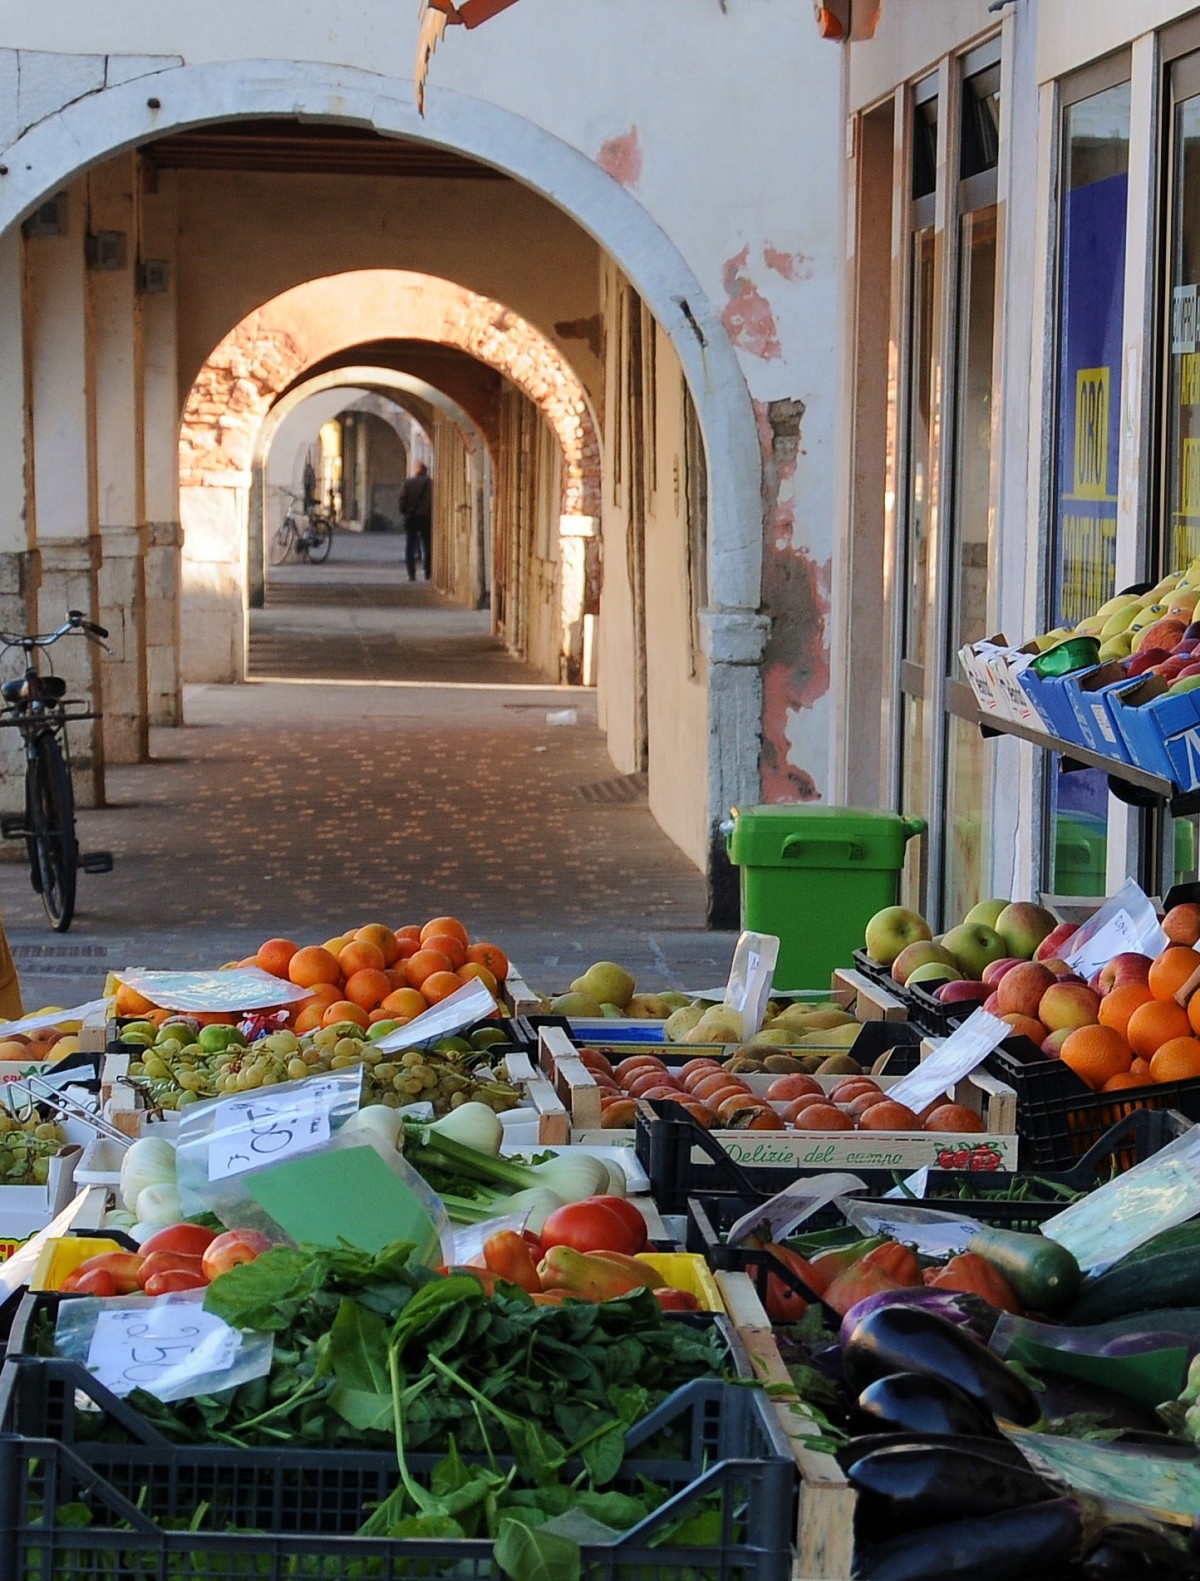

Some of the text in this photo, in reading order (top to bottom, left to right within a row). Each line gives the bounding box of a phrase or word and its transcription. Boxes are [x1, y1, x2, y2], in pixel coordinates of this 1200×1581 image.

[1079, 380, 1104, 485] ORO
[724, 1143, 794, 1164] Delizie
[804, 1144, 835, 1163] del
